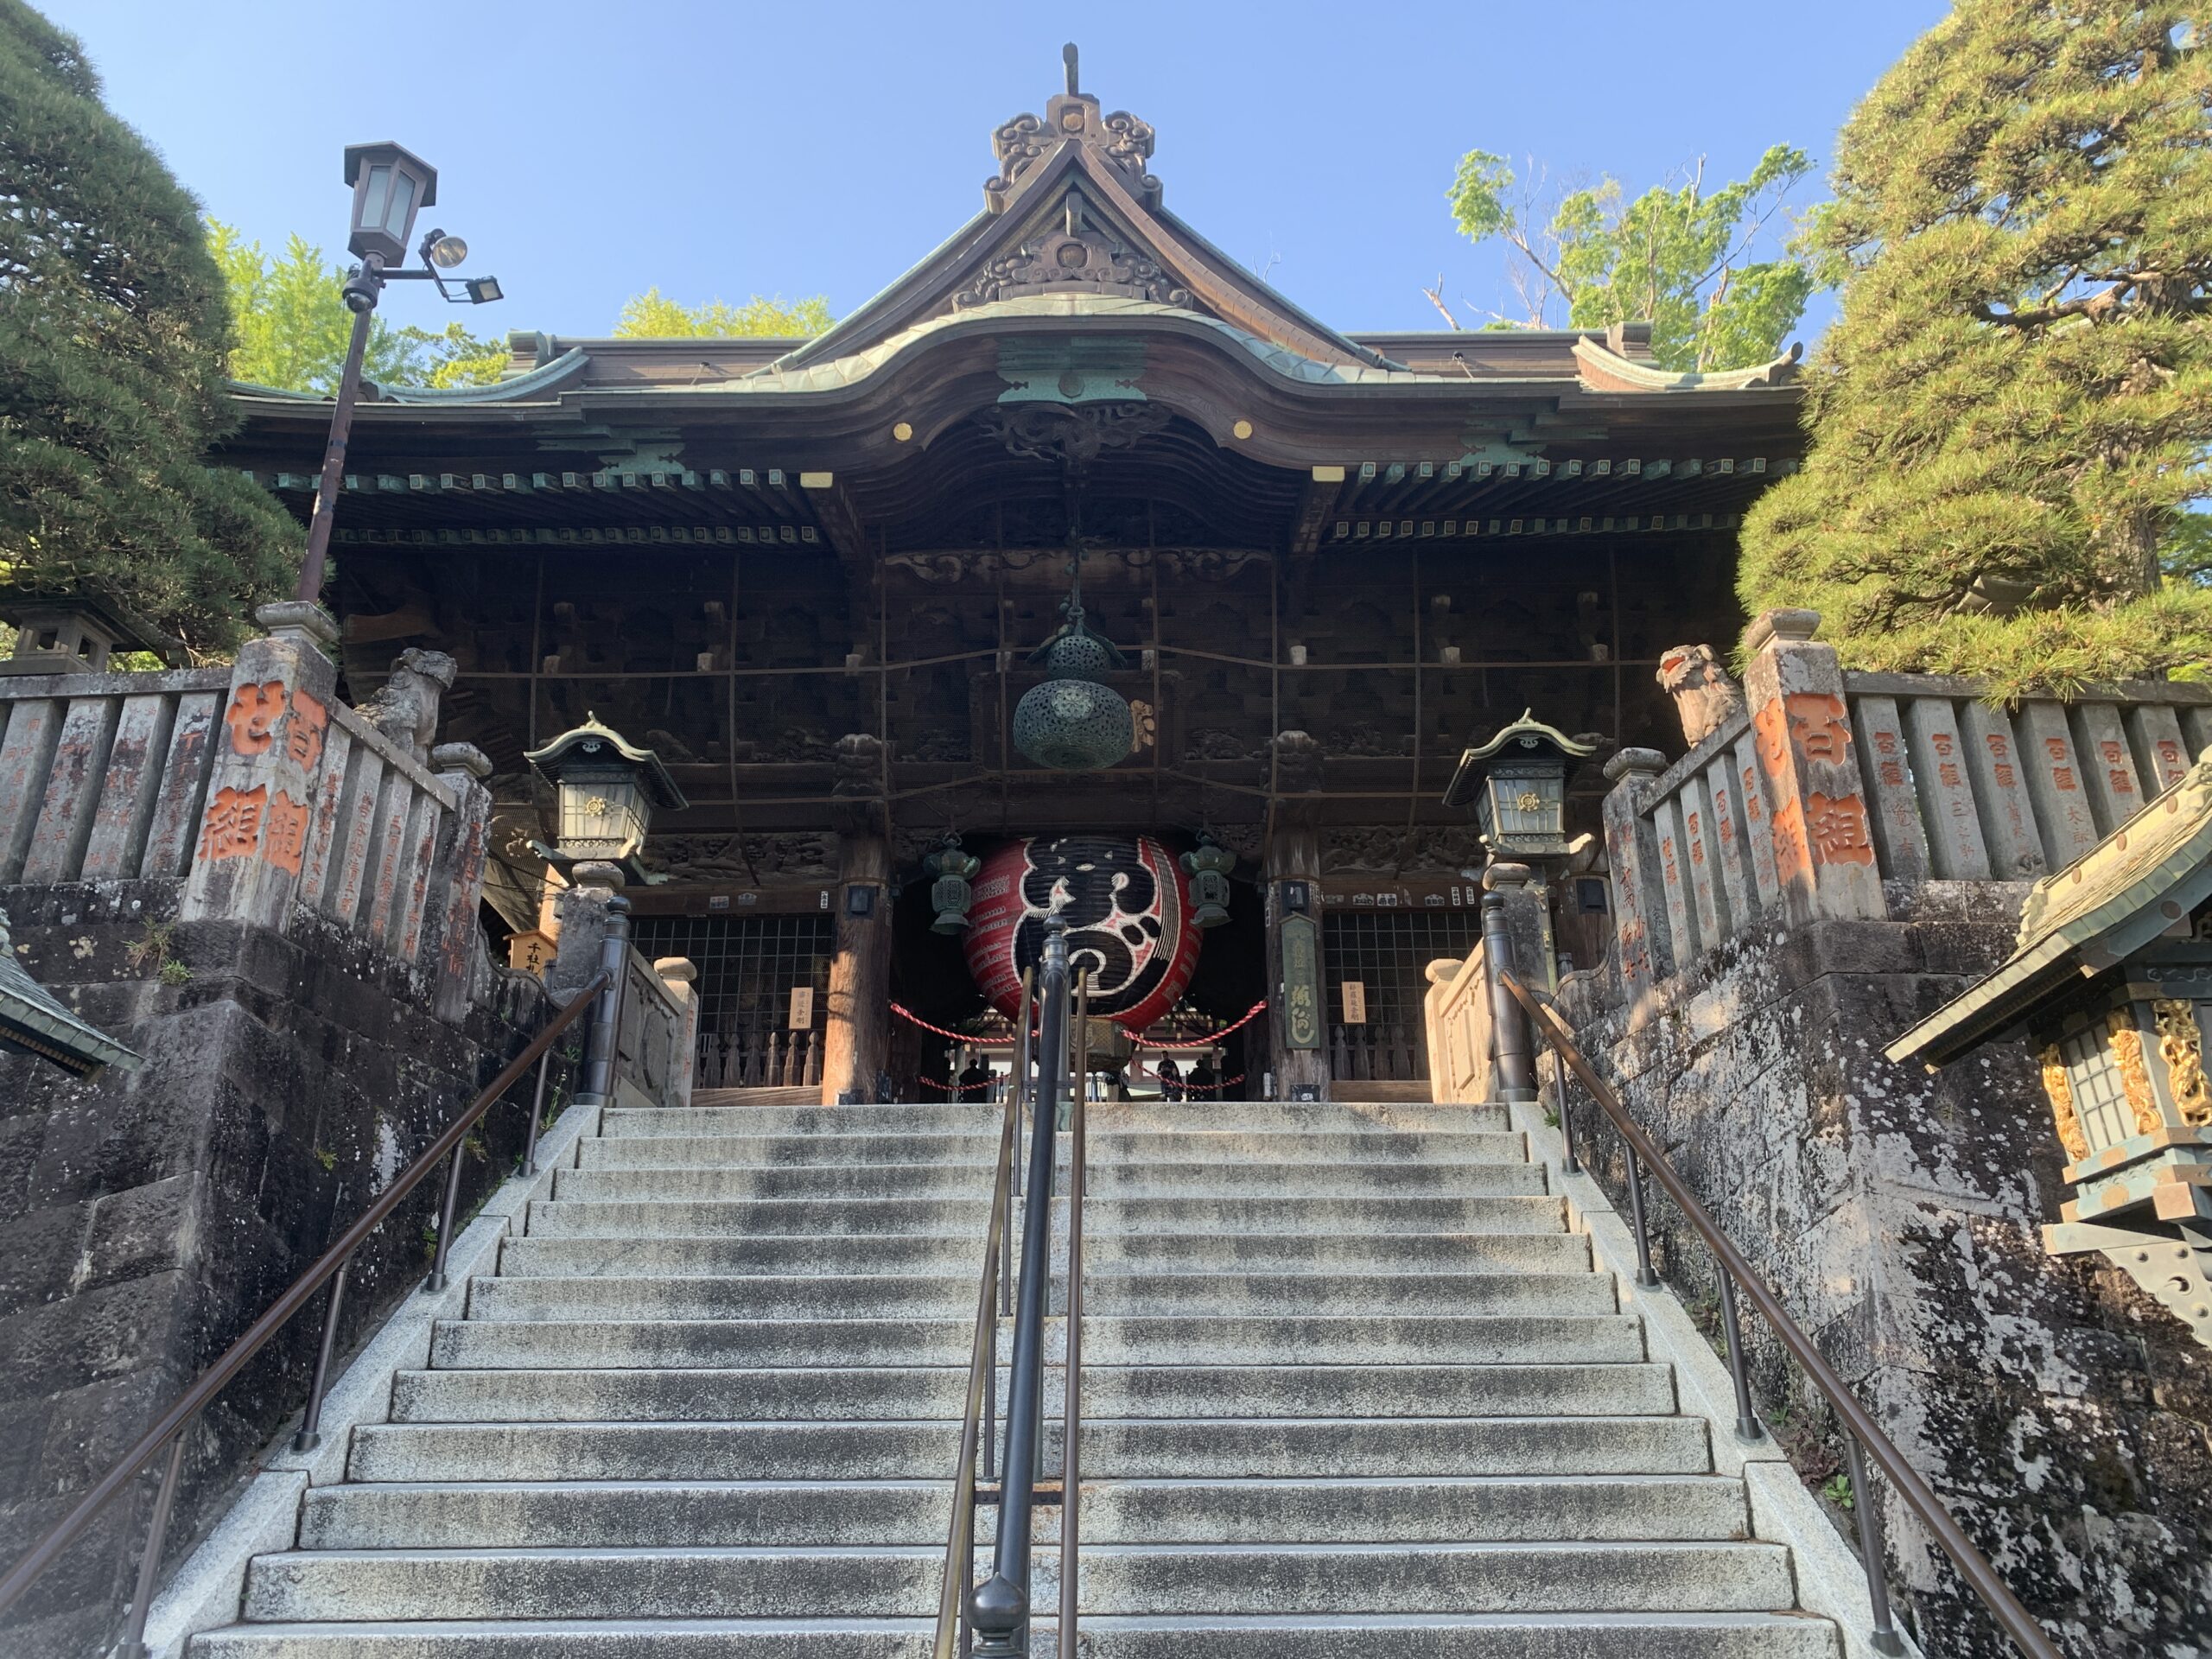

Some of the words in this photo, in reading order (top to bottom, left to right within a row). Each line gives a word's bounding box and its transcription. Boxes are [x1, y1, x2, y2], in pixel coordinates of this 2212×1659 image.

[1787, 691, 1874, 867] 百組
[1874, 732, 1904, 786] 百組
[1931, 734, 1963, 788] 百組
[1986, 734, 2018, 788] 百組
[2045, 737, 2077, 791] 百組
[2100, 741, 2133, 793] 百組
